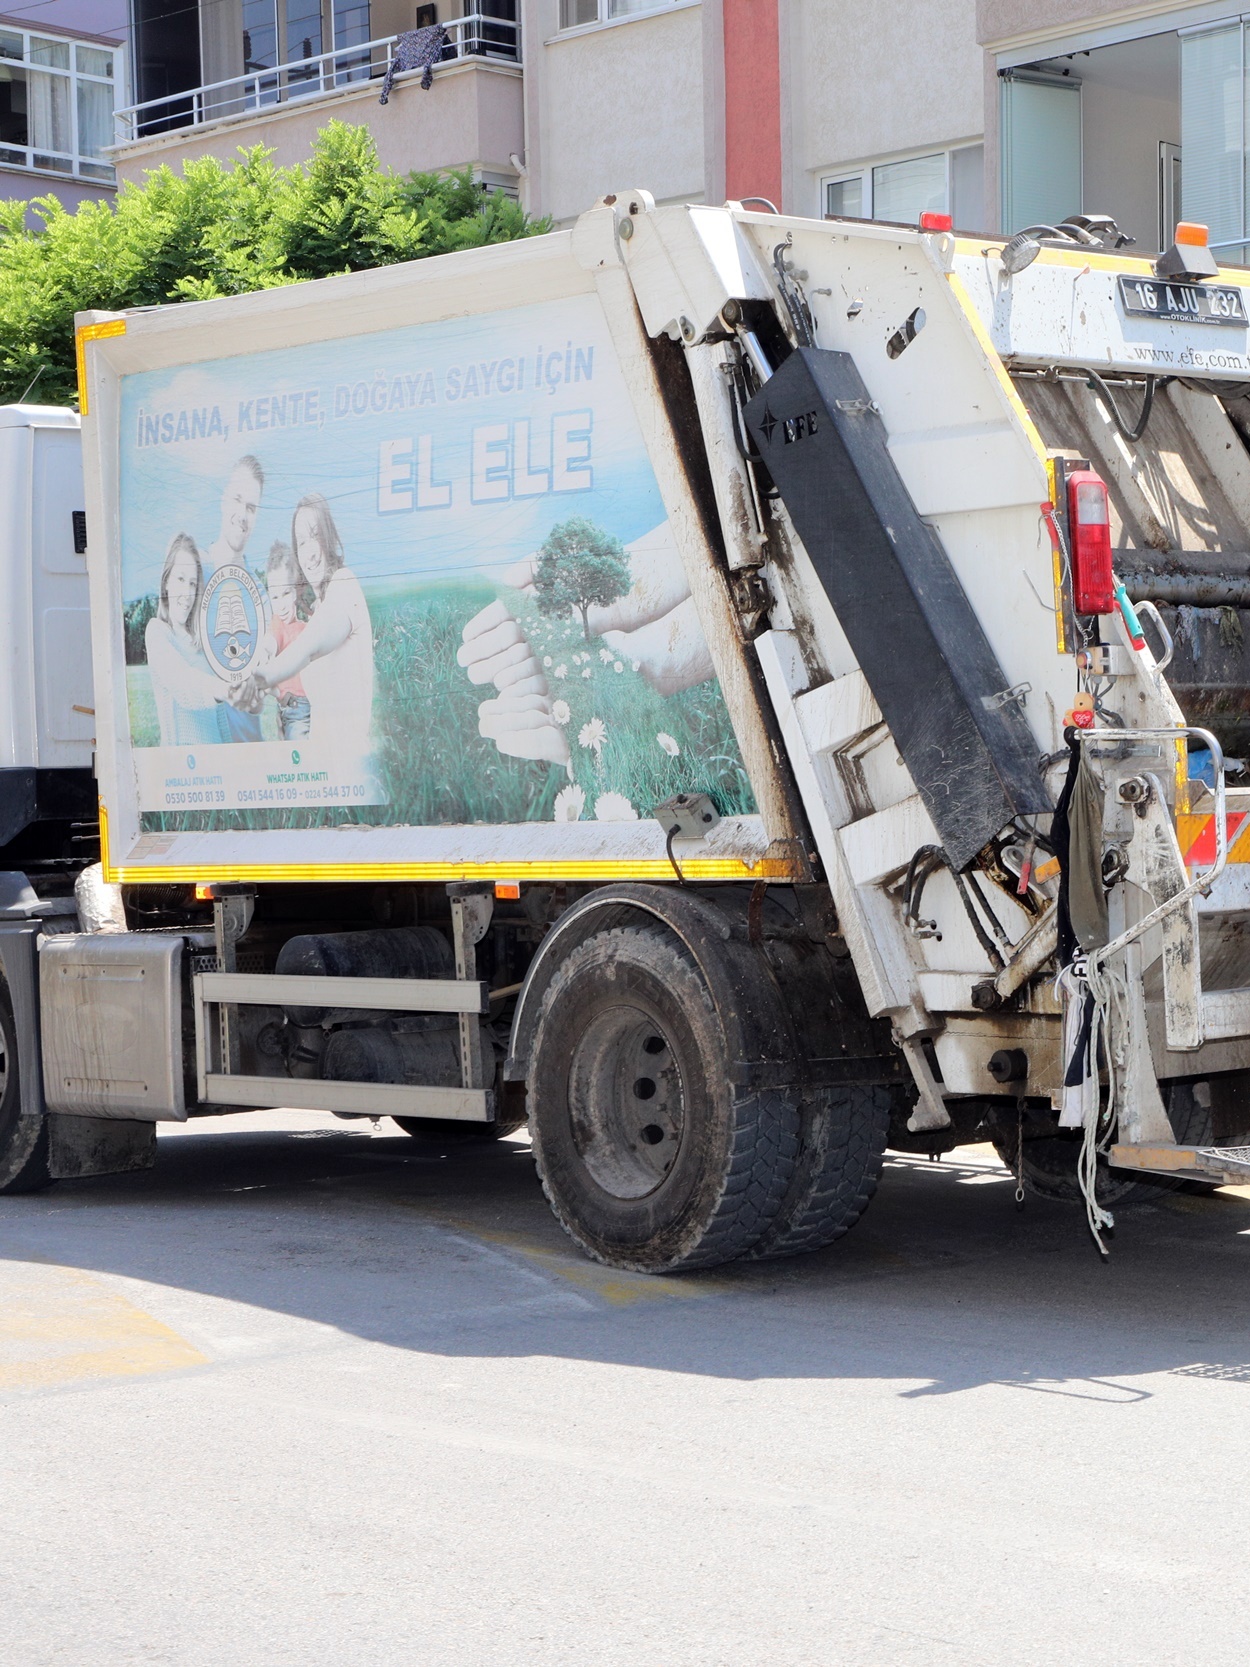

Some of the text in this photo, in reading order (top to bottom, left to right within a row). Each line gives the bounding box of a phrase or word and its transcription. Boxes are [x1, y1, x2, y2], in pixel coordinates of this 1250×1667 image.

[1135, 282, 1241, 318] 16 AJU 232
[137, 340, 594, 447] İNSANA, KENTE, DOĞAYA SAYGI İÇİN
[782, 410, 819, 445] EFE
[377, 408, 593, 517] EL ELE
[201, 571, 226, 611] MUDANYA
[230, 672, 243, 682] 1919
[237, 790, 256, 802] 0541
[258, 789, 273, 801] 544
[275, 788, 284, 800] 16
[286, 788, 297, 800] 09
[305, 789, 321, 799] 0224
[323, 786, 338, 798] 544
[341, 785, 350, 797] 37
[353, 785, 364, 797] 00
[266, 772, 328, 783] WHATSAP ATIK HATTI
[165, 790, 225, 804] 0530 500 81 39
